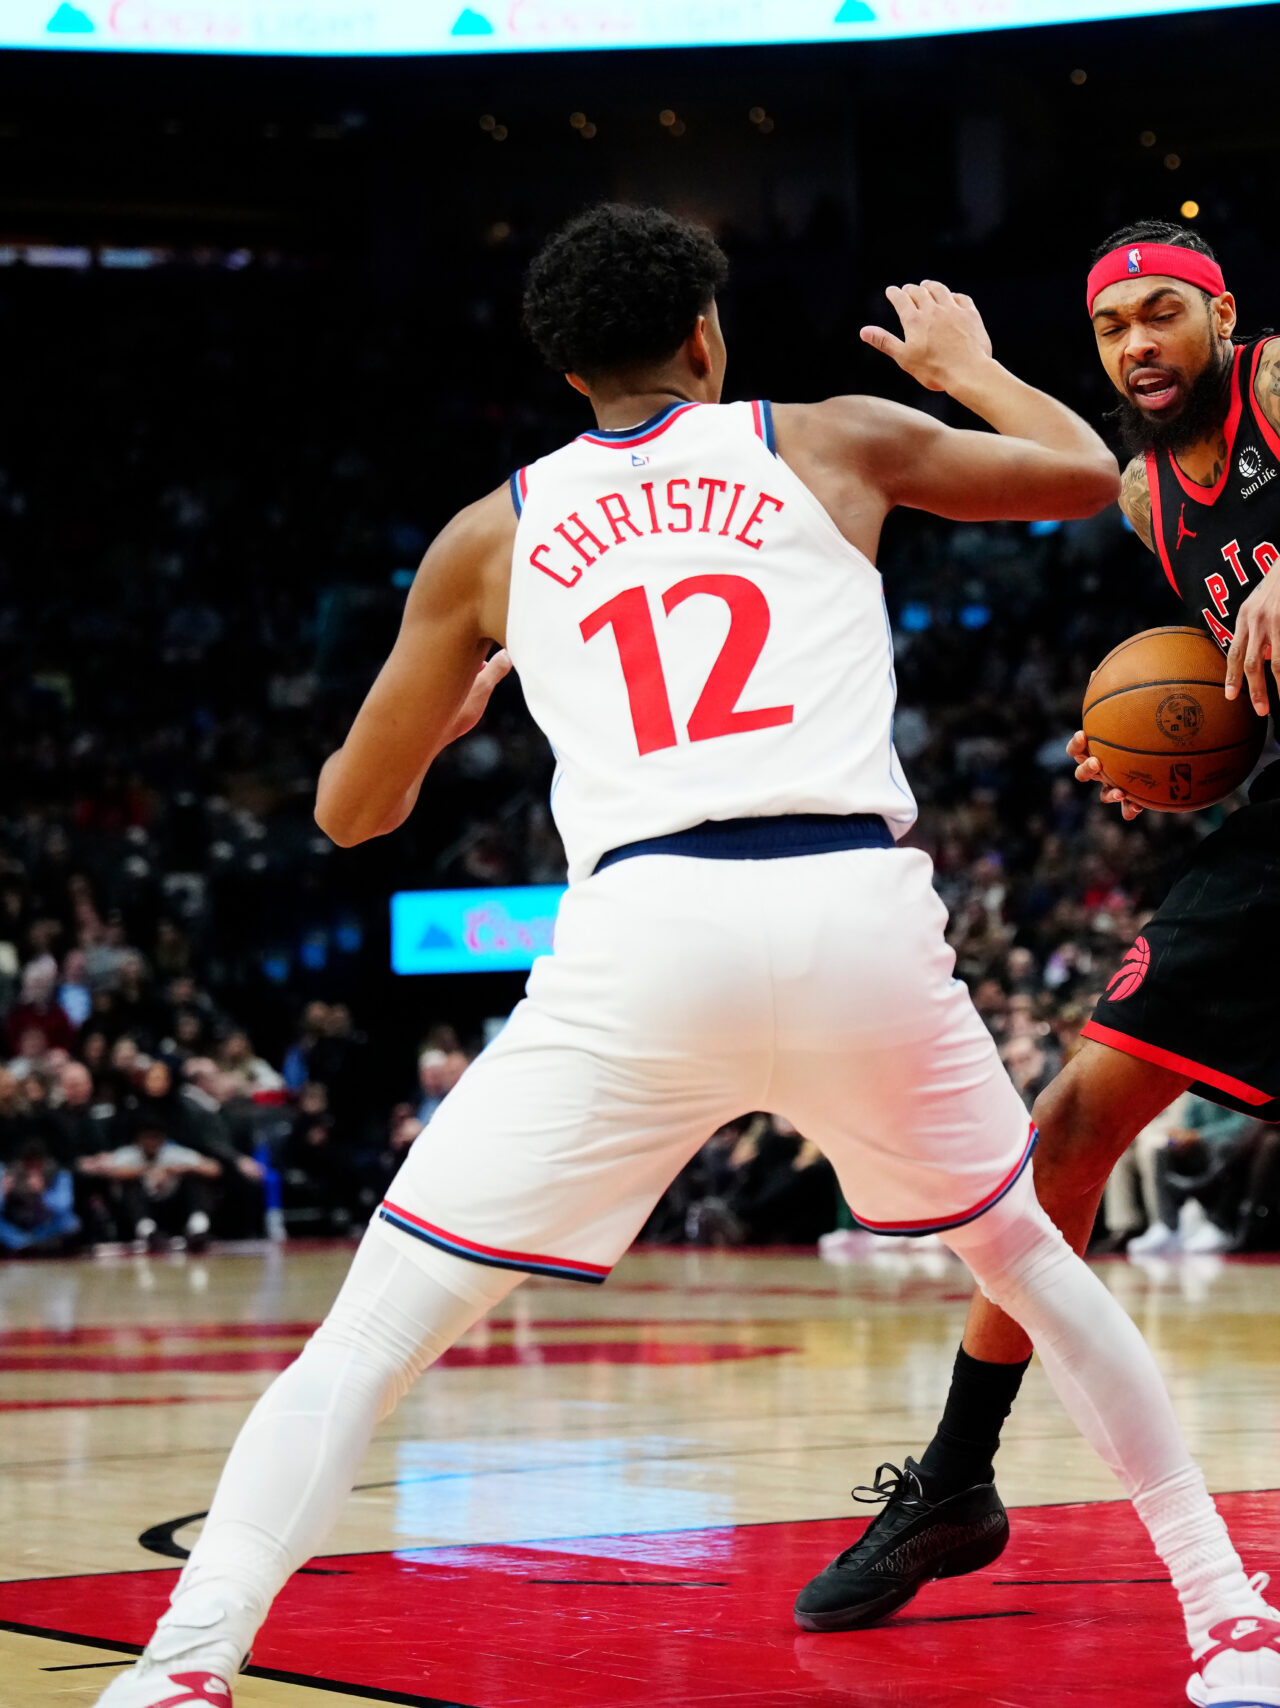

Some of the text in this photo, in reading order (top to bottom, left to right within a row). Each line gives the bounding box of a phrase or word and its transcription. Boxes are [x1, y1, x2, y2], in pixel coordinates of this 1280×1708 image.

[529, 477, 784, 589] CHRISTIE
[1240, 467, 1278, 500] Sun Life
[578, 573, 794, 757] 12
